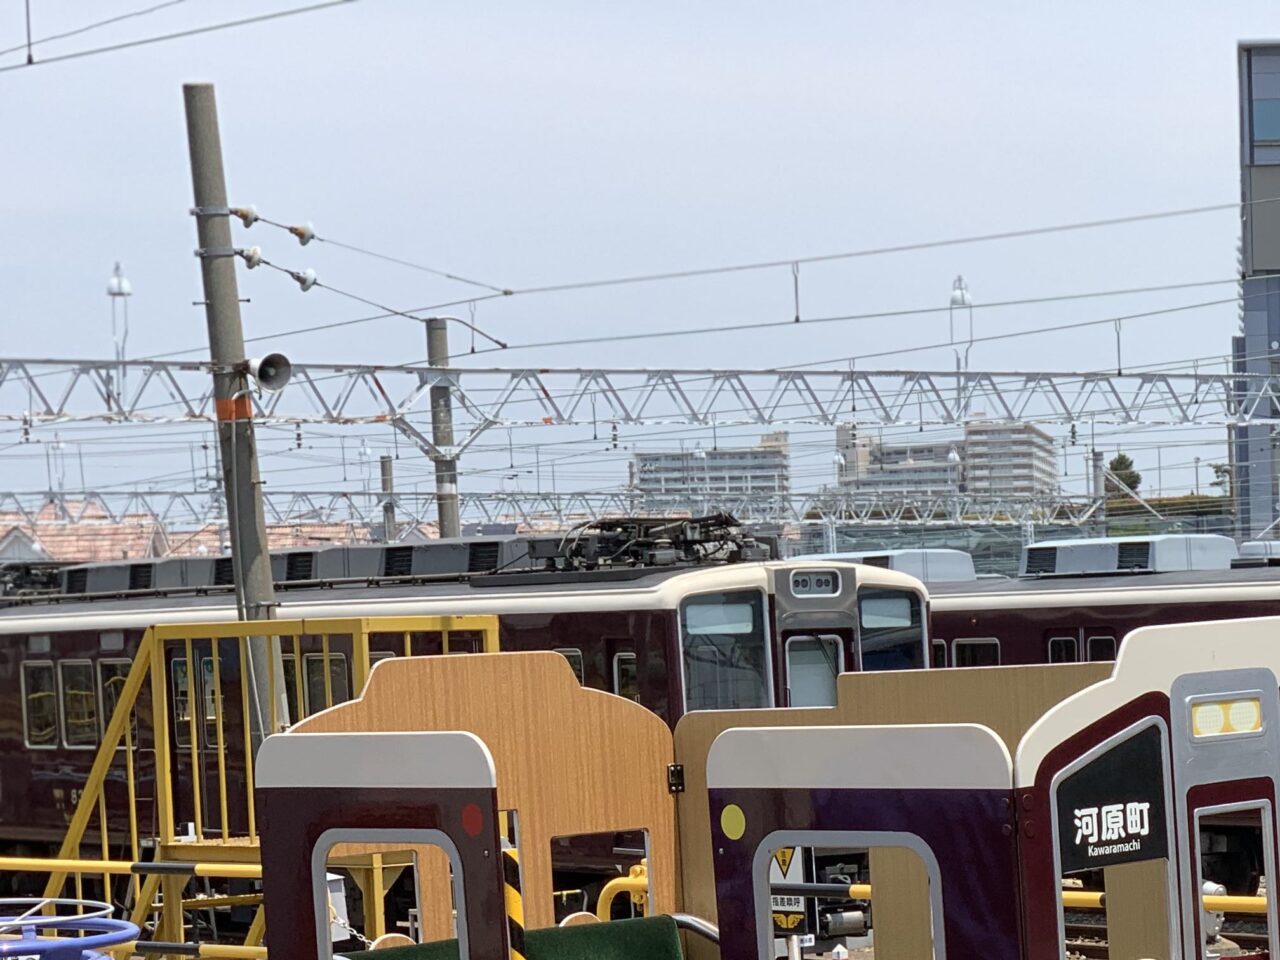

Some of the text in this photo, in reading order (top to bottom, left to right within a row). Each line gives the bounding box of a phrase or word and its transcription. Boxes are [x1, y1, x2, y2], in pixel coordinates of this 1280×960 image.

[1074, 802, 1150, 845] 河原町
[1088, 838, 1141, 857] Kawaramachi
